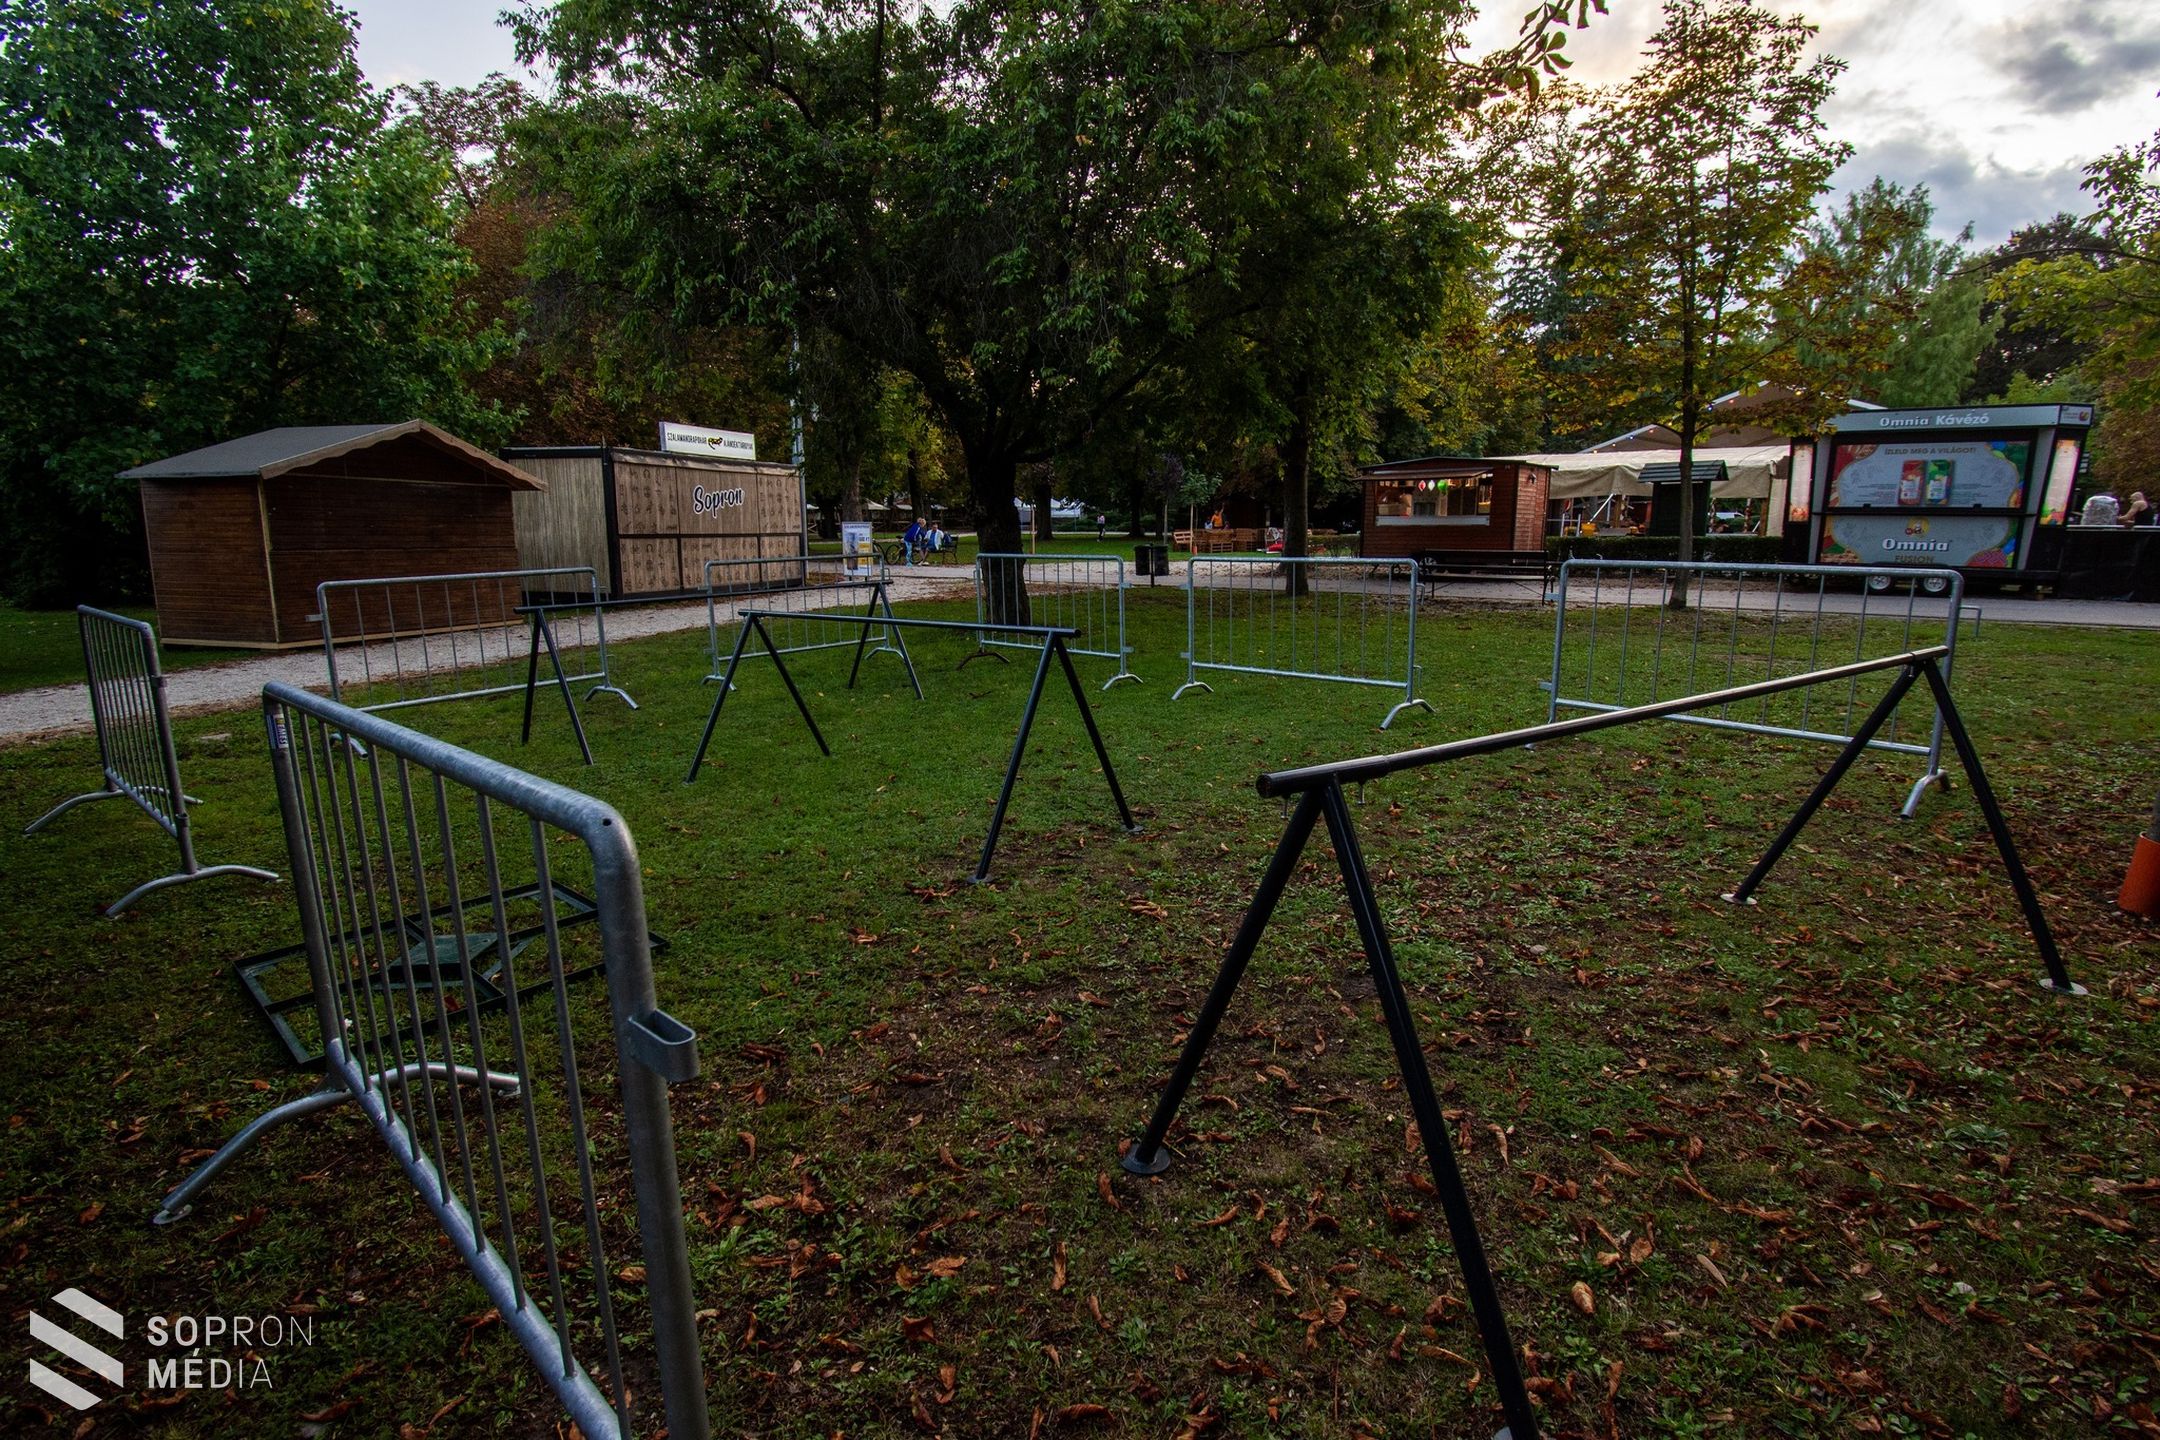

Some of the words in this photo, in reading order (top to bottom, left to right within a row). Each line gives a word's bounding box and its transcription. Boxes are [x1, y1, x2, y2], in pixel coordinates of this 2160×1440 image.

[1880, 417, 1929, 426] Omnia
[1936, 413, 1990, 425] Kávézó
[693, 484, 745, 518] Sopron
[1882, 538, 1949, 552] Omnia
